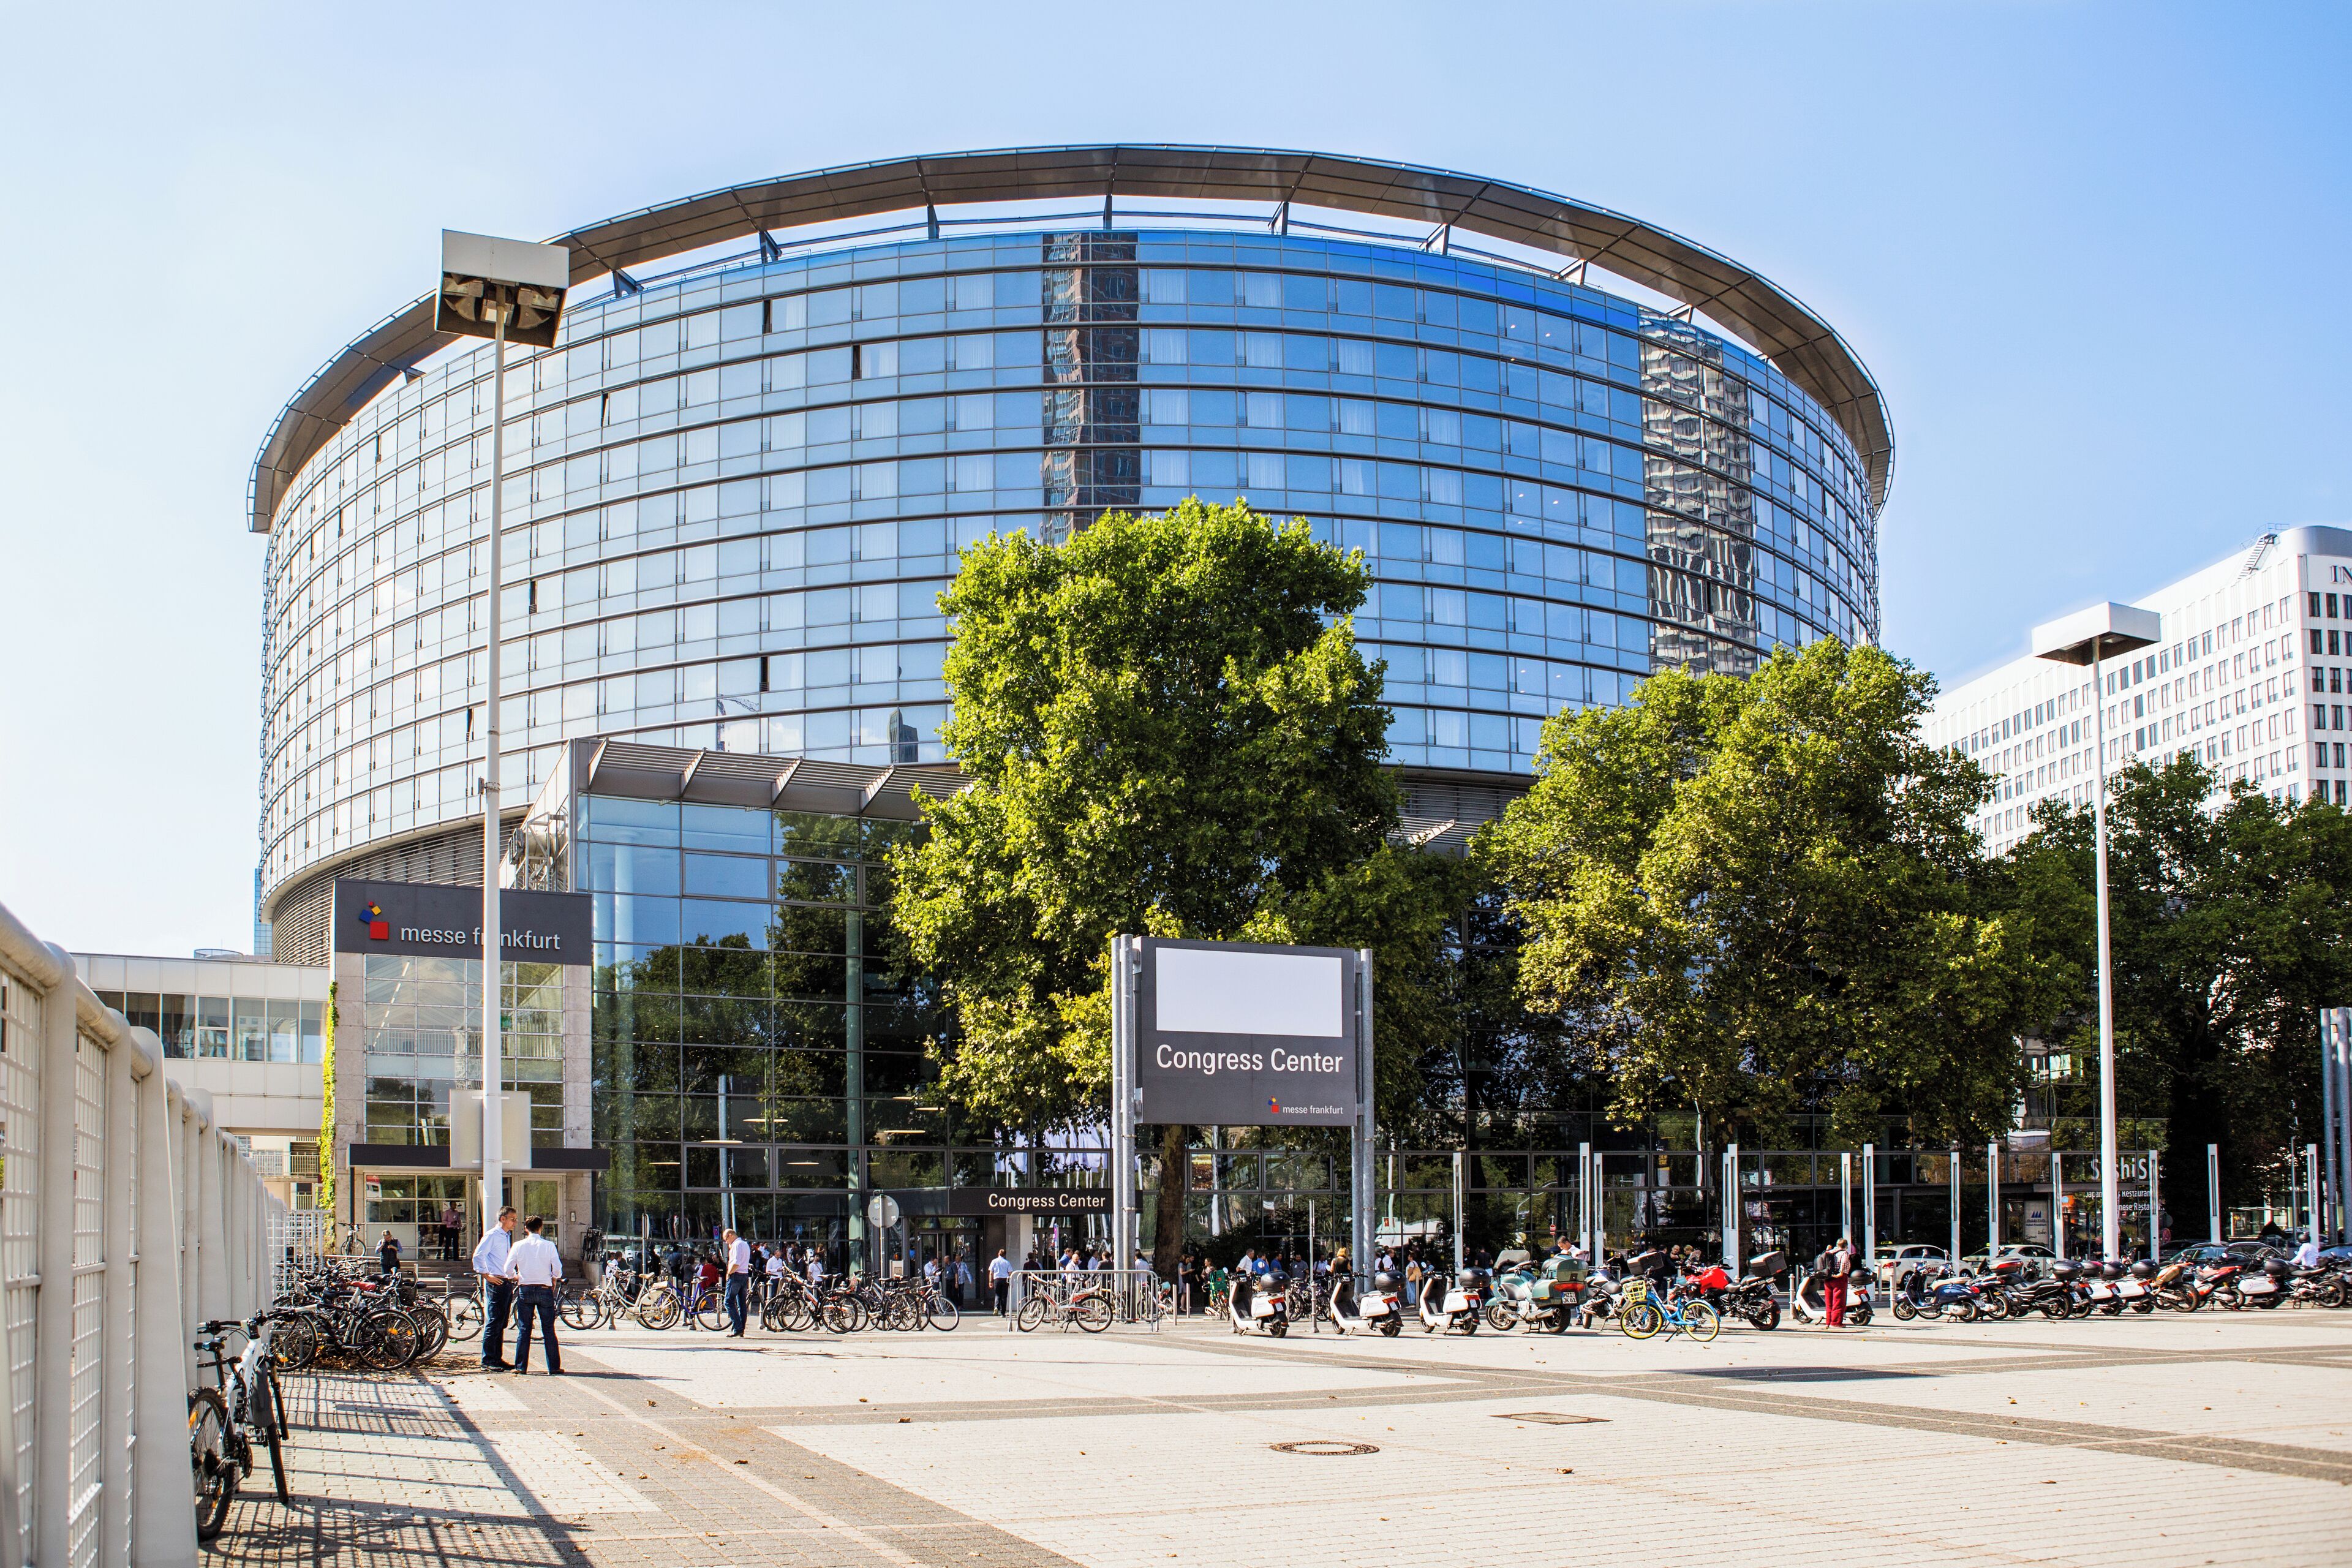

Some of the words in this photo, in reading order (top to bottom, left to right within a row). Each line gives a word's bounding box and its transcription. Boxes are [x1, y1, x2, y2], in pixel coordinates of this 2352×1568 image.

[401, 927, 466, 944] messe
[472, 927, 561, 950] frnkfurt
[1156, 1044, 1263, 1075] Congress
[1270, 1047, 1343, 1072] Center
[1282, 1106, 1308, 1115] messe
[1310, 1104, 1344, 1115] frankfurt
[988, 1193, 1055, 1211] Congress
[1059, 1193, 1106, 1208] Center
